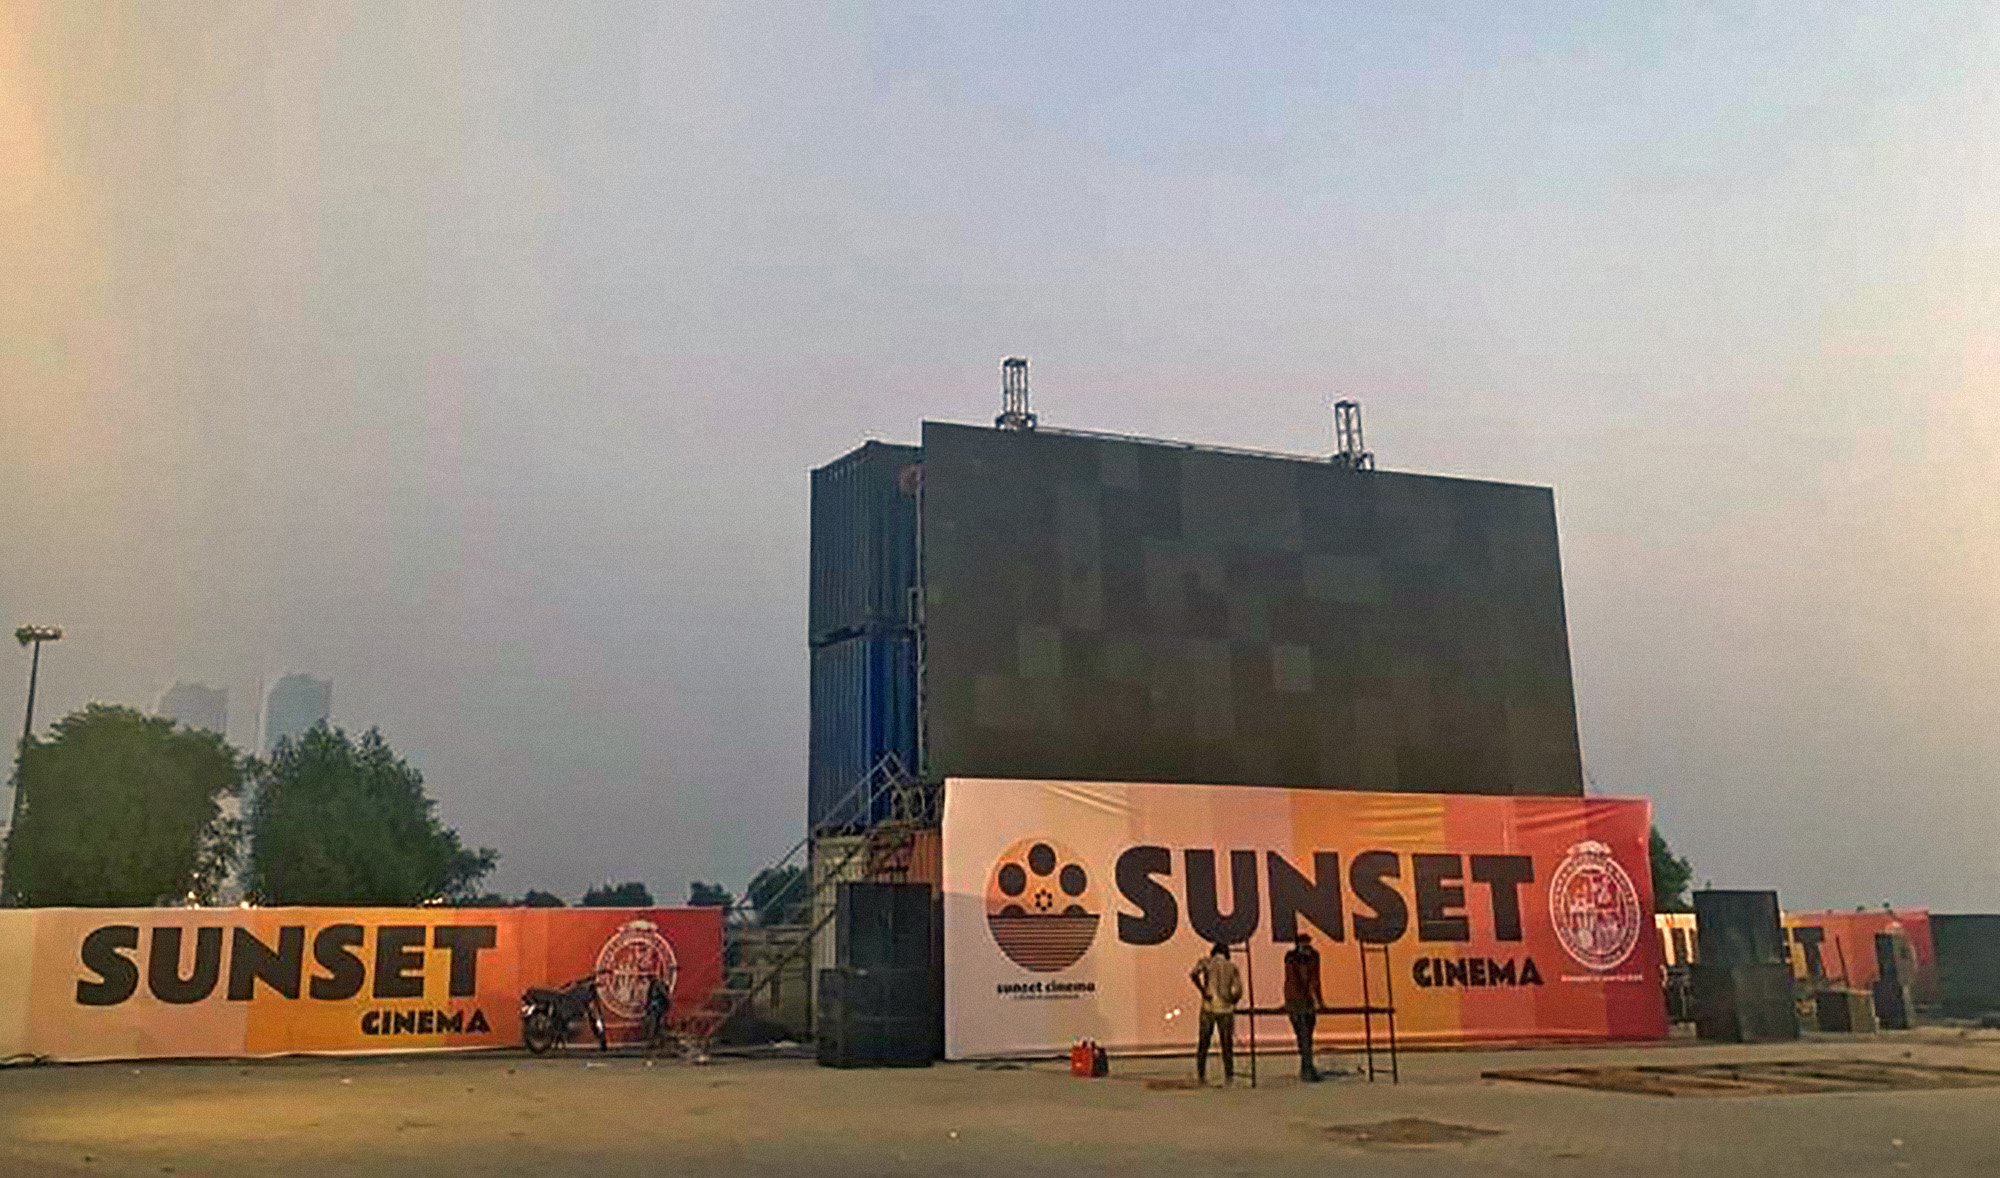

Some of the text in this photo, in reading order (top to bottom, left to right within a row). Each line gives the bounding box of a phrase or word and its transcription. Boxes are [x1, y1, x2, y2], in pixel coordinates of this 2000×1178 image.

[1115, 845, 1535, 946] SUNSET
[77, 924, 497, 1006] SUNSET
[1412, 957, 1545, 987] CINEMA
[361, 1008, 492, 1035] CINEMA
